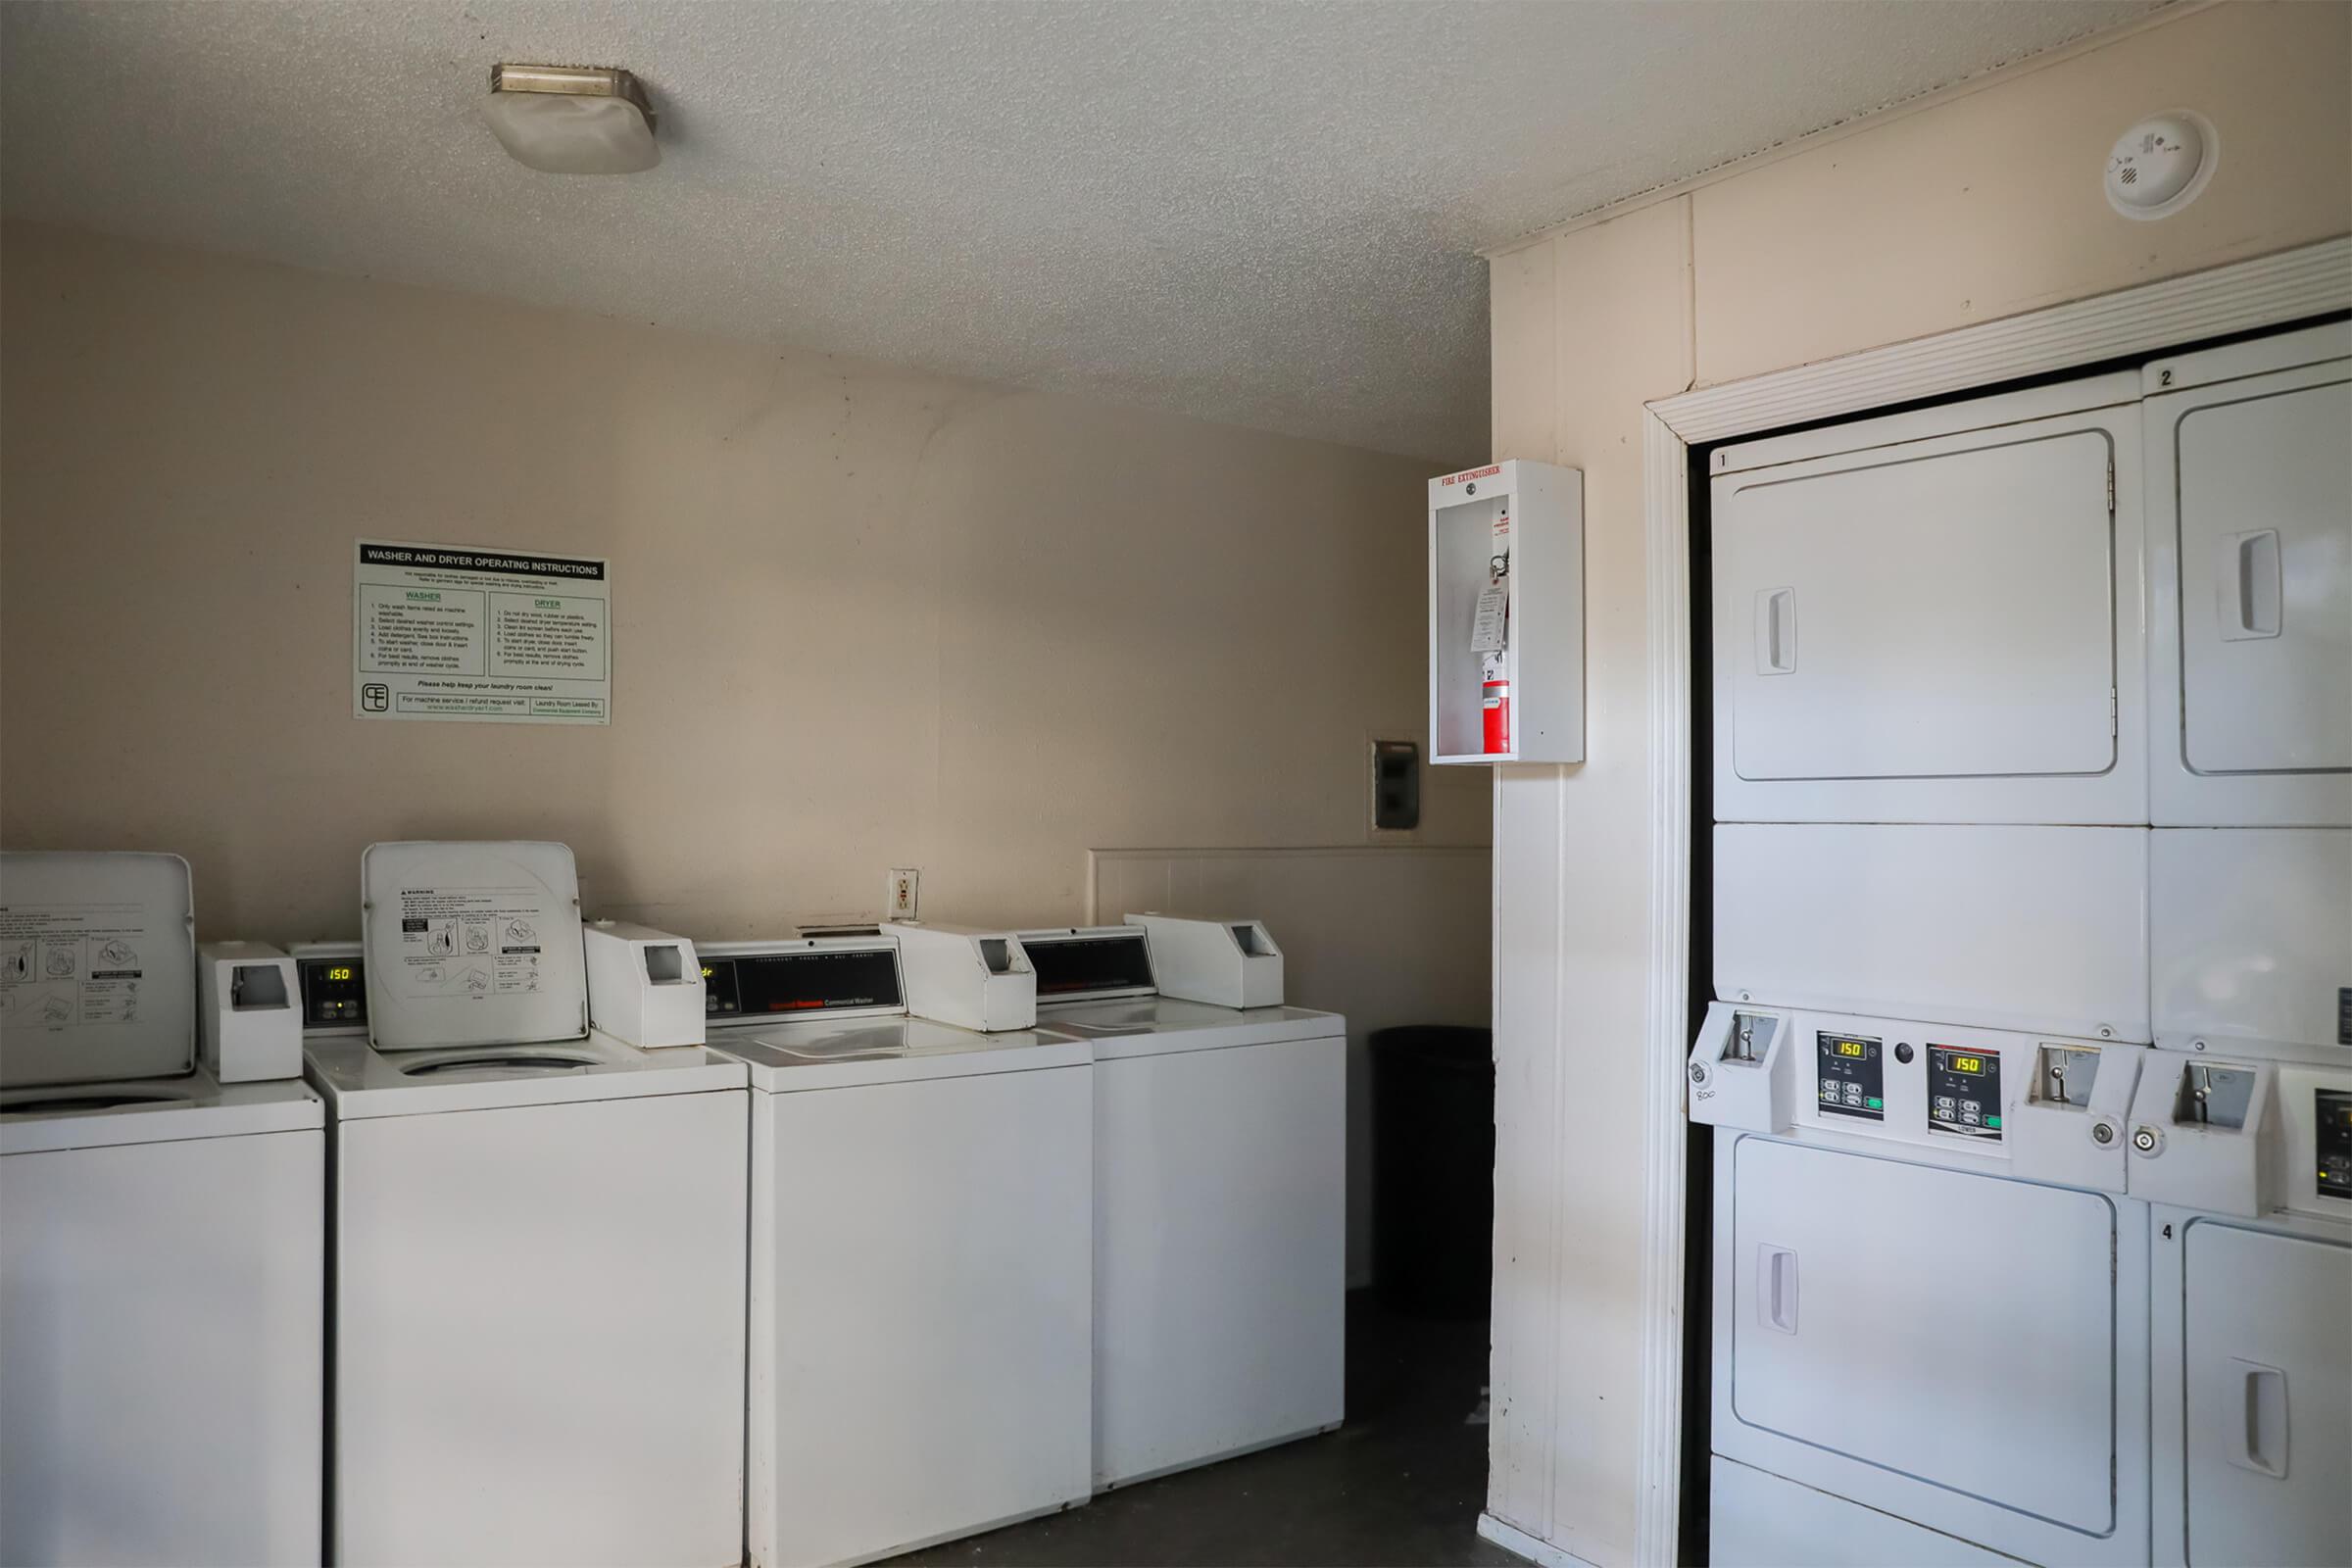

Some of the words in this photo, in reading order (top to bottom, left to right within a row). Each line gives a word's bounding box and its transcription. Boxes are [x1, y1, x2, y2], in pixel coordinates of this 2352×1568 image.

[2162, 370, 2171, 386] 2
[1721, 455, 1725, 466] 1
[1443, 476, 1454, 486] FIRE
[1458, 466, 1500, 482] EXTINGUISHER
[368, 550, 412, 562] WASHER
[415, 554, 436, 563] AND
[439, 555, 472, 565] DRYER
[474, 558, 529, 570] OPERATING
[531, 563, 598, 575] INSTRUCTIONS
[406, 592, 441, 601] WASHER
[535, 600, 561, 609] DRYER
[490, 682, 514, 691] laundry
[329, 969, 349, 979] 150
[1840, 1043, 1860, 1055] 150
[1956, 1057, 1979, 1071] 150
[2163, 1225, 2172, 1240] 4
